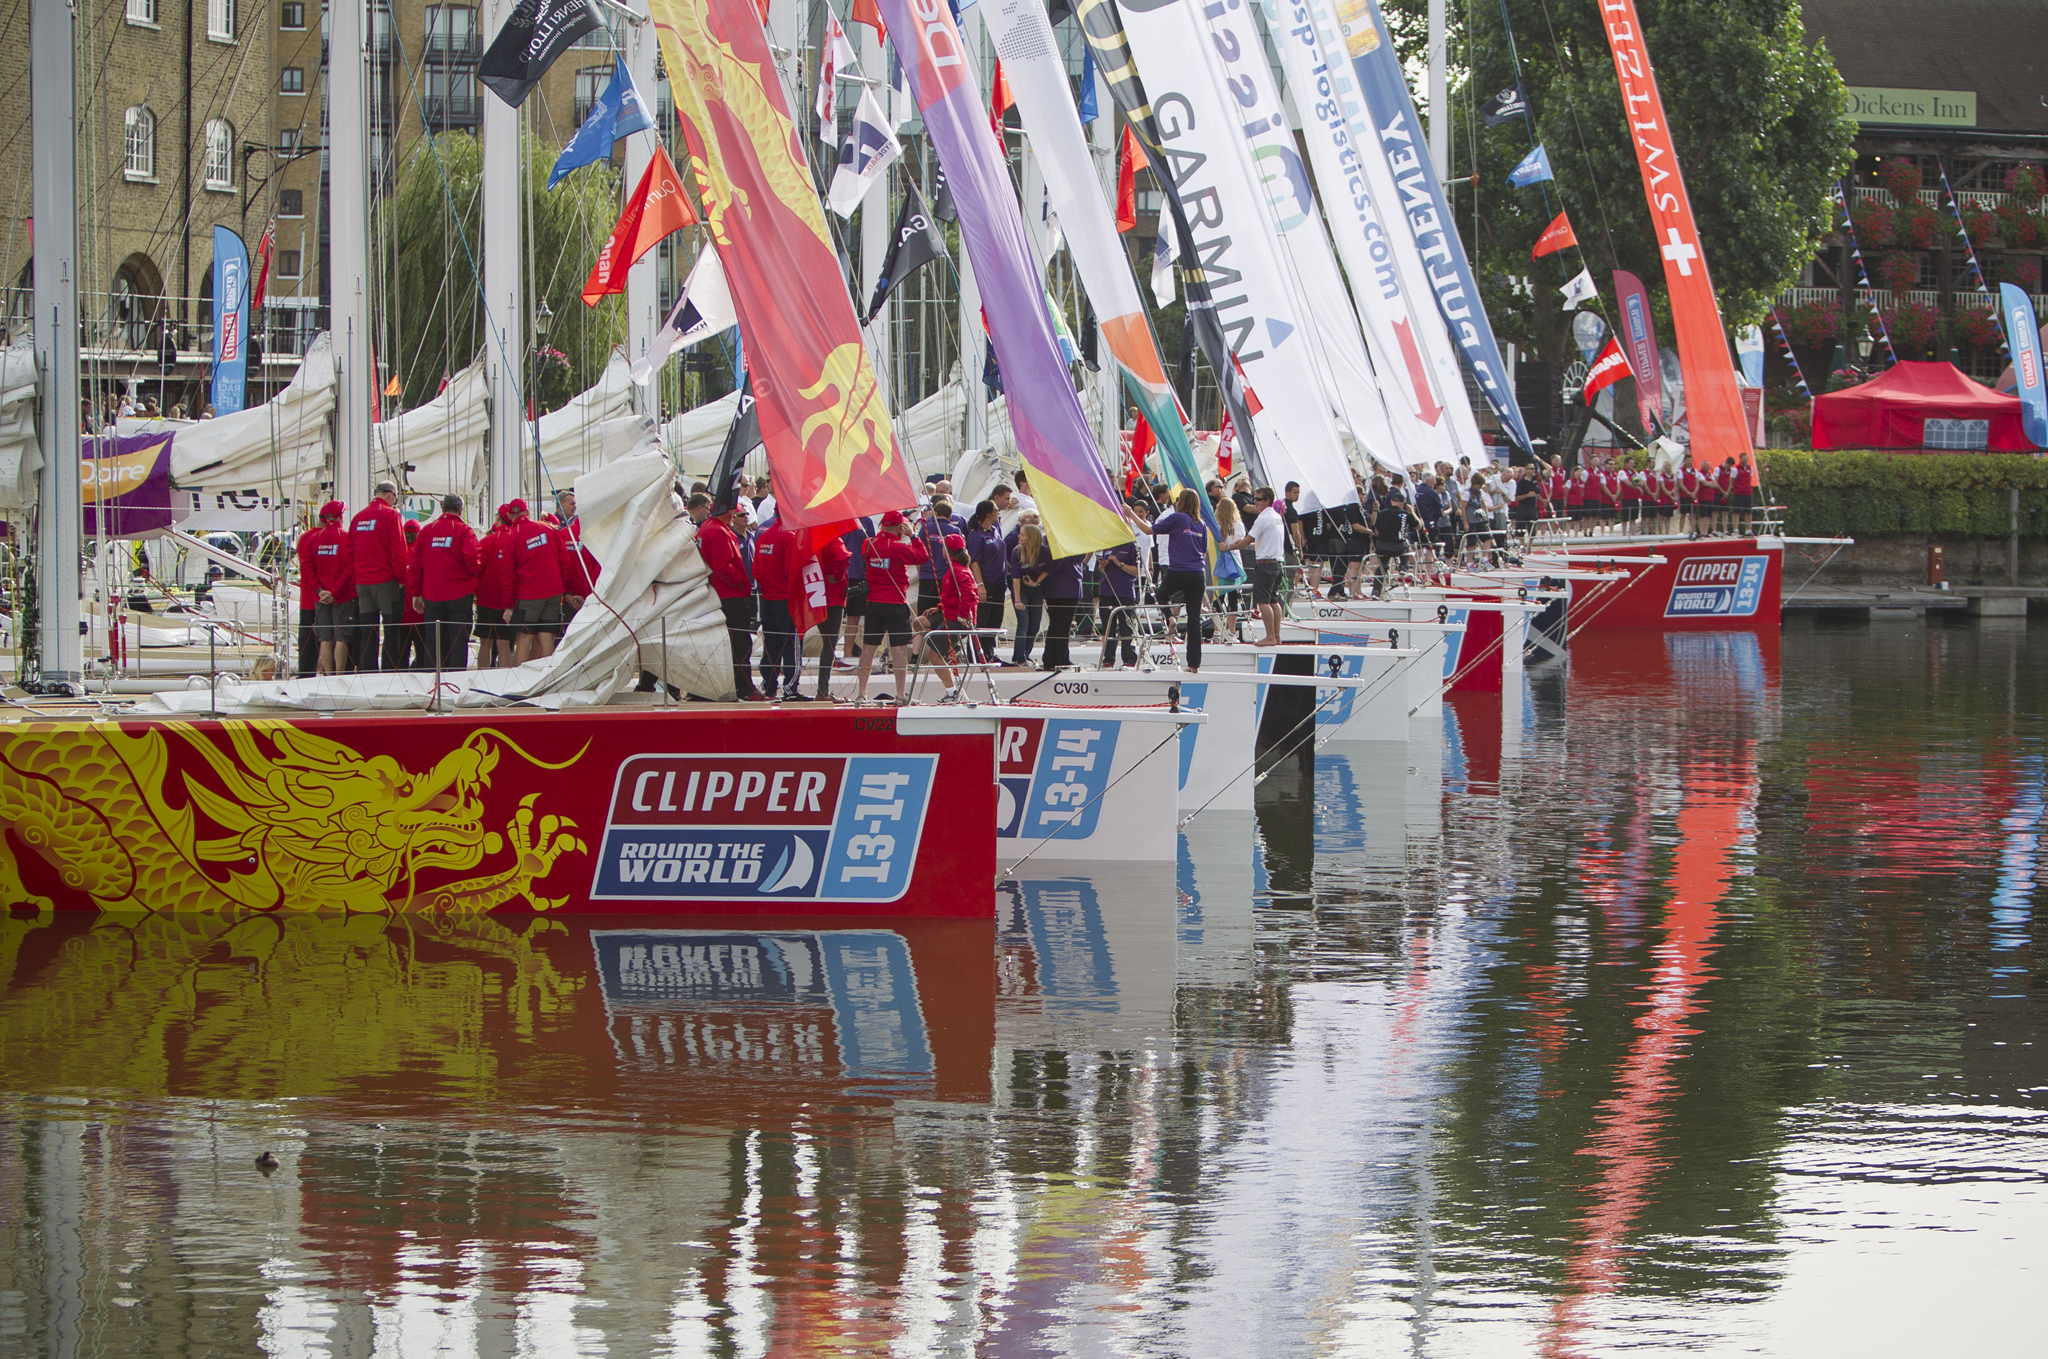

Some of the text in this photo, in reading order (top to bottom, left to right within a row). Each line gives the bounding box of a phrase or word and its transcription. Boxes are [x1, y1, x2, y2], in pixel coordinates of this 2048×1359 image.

[1844, 93, 1967, 118] Dickens Inn
[1289, 0, 1401, 301] sp-logistics.com
[1153, 91, 1265, 367] GARMIN
[1682, 563, 1738, 581] CLIPPER
[1676, 591, 1718, 600] ROUND THE
[1737, 563, 1760, 608] 13-14
[1318, 608, 1344, 618] CV27
[1674, 599, 1716, 610] WORLD
[1053, 682, 1089, 695] CV30
[854, 717, 894, 732] CV22
[1038, 727, 1102, 827] 13-14
[630, 770, 827, 813] CLIPPER
[840, 771, 910, 884] 13-14
[618, 842, 766, 860] ROUND THE
[618, 859, 762, 885] WORLD
